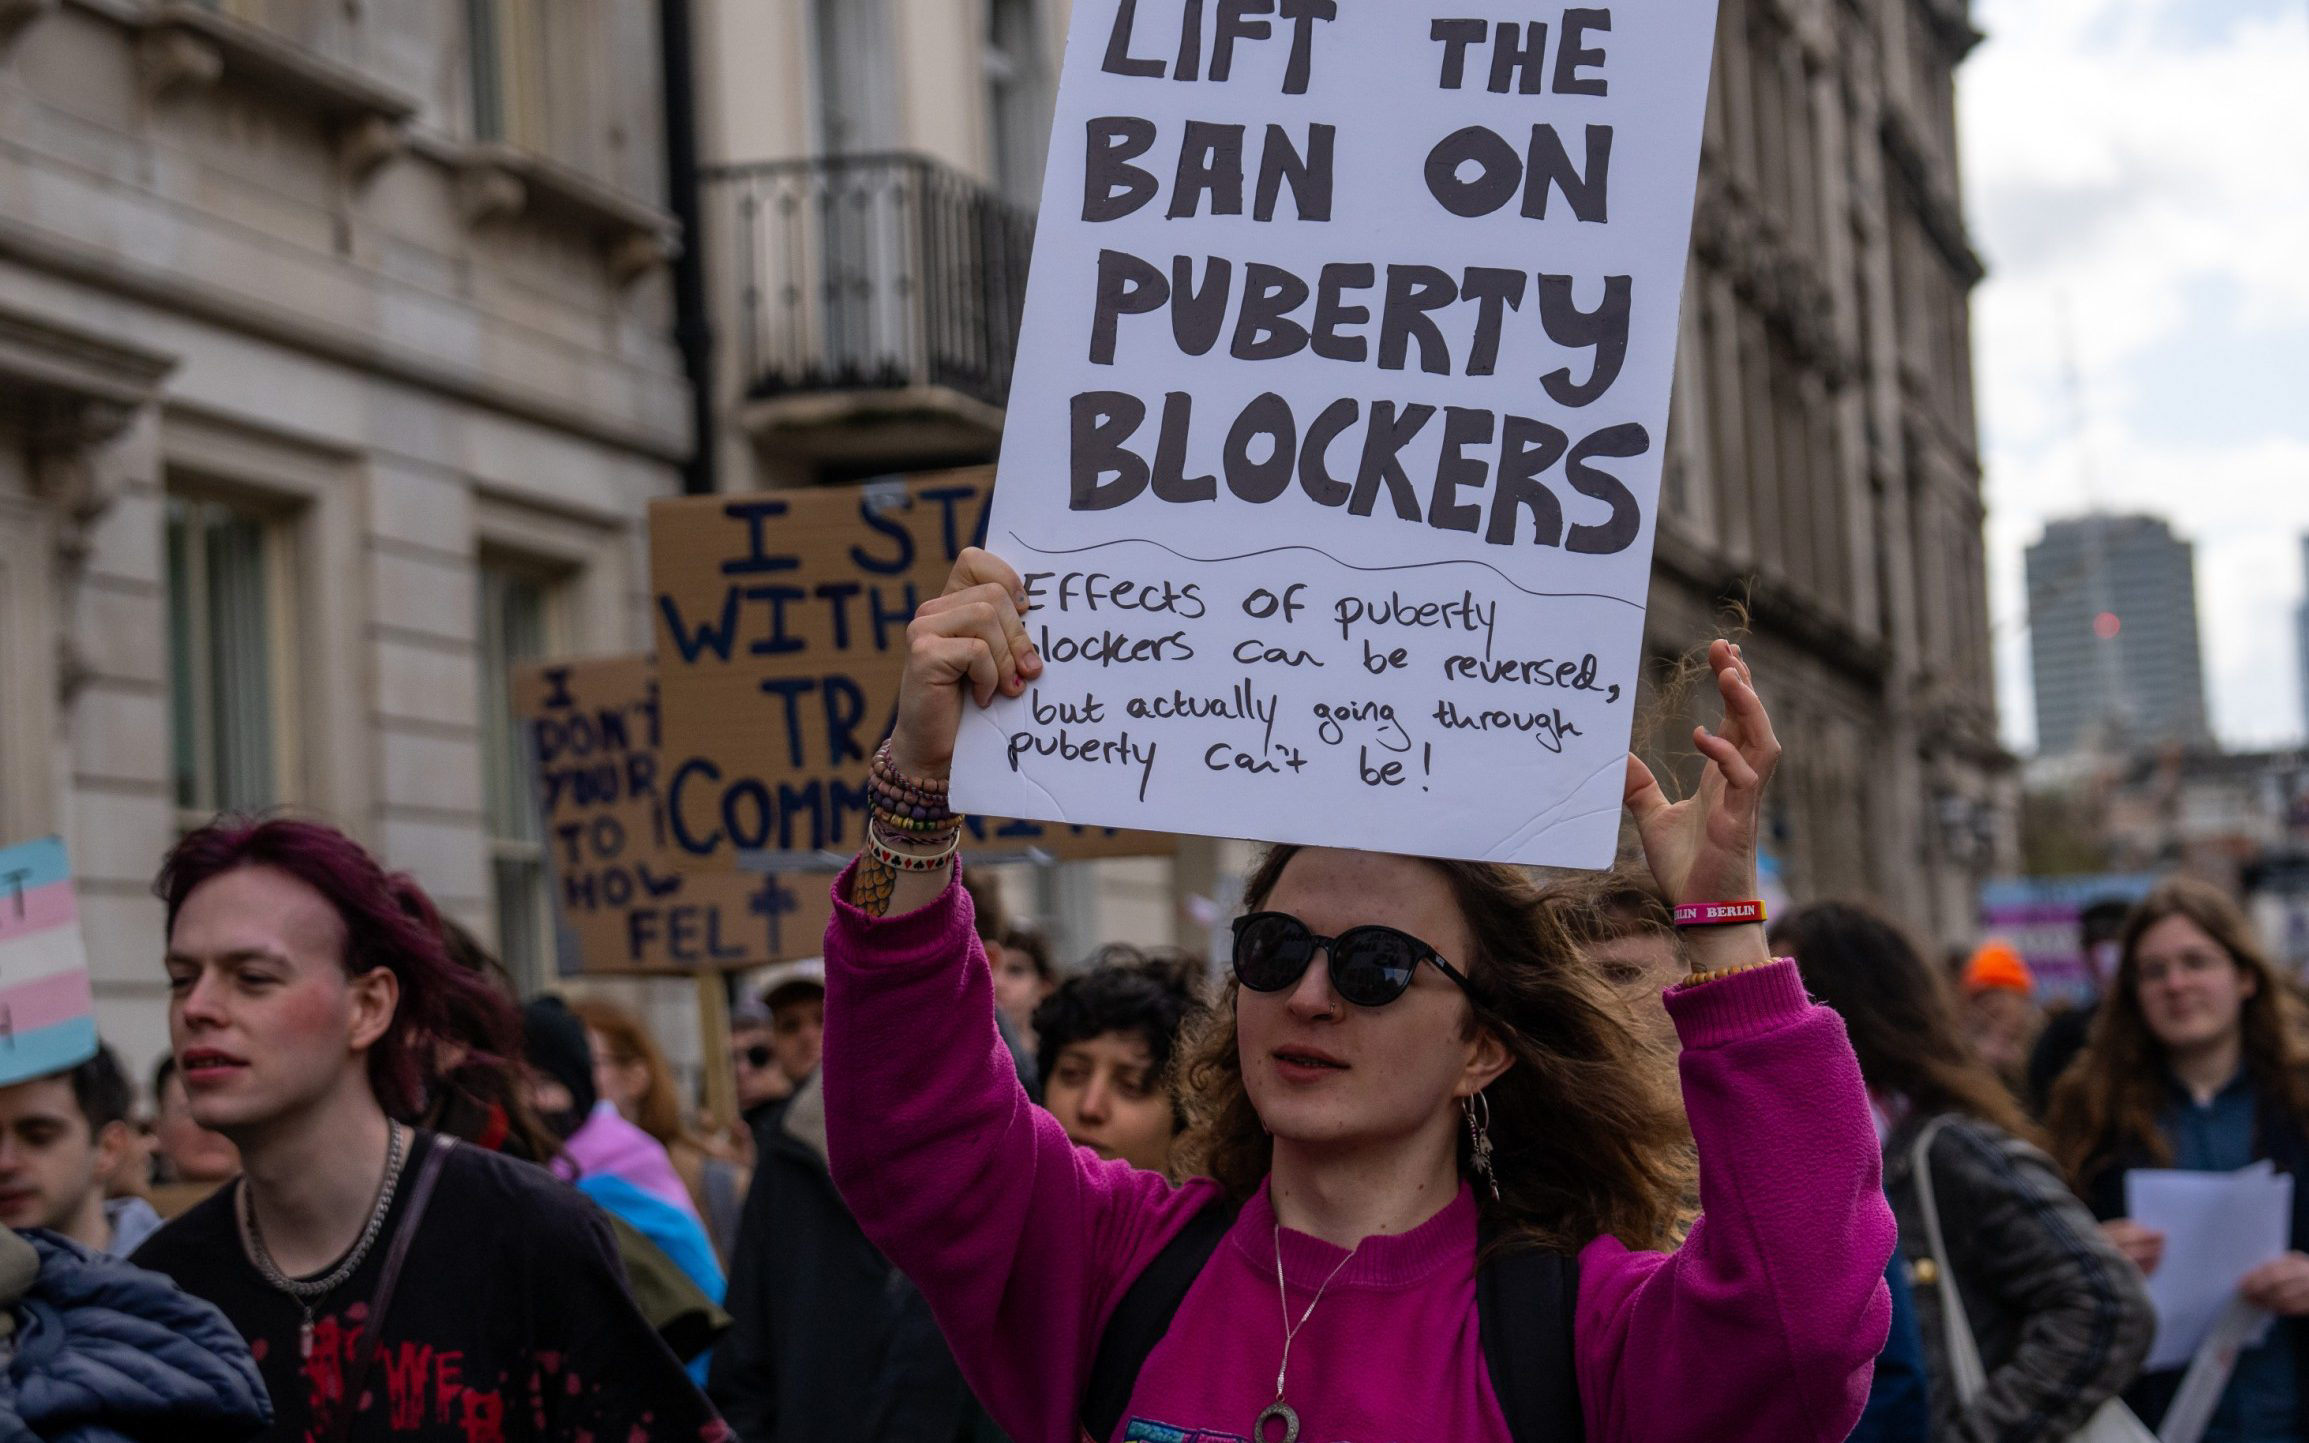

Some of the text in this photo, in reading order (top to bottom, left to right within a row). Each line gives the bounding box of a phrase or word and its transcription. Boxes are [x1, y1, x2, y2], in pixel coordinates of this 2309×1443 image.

[1101, 0, 1611, 97] LIFT THE
[1081, 117, 1613, 224] BAN ON
[1089, 249, 1632, 408] PUBERTY
[1069, 391, 1649, 554] BLOCKERS
[721, 501, 800, 575] I
[659, 582, 916, 663] WITH
[1023, 572, 1496, 662] Effects of puberty
[1021, 621, 1622, 704] lockers can be reversed,
[1032, 677, 1584, 757] but actually going through
[1007, 729, 1157, 803] puberty
[1360, 741, 1432, 793] be!
[1706, 904, 1755, 918] BERLIN
